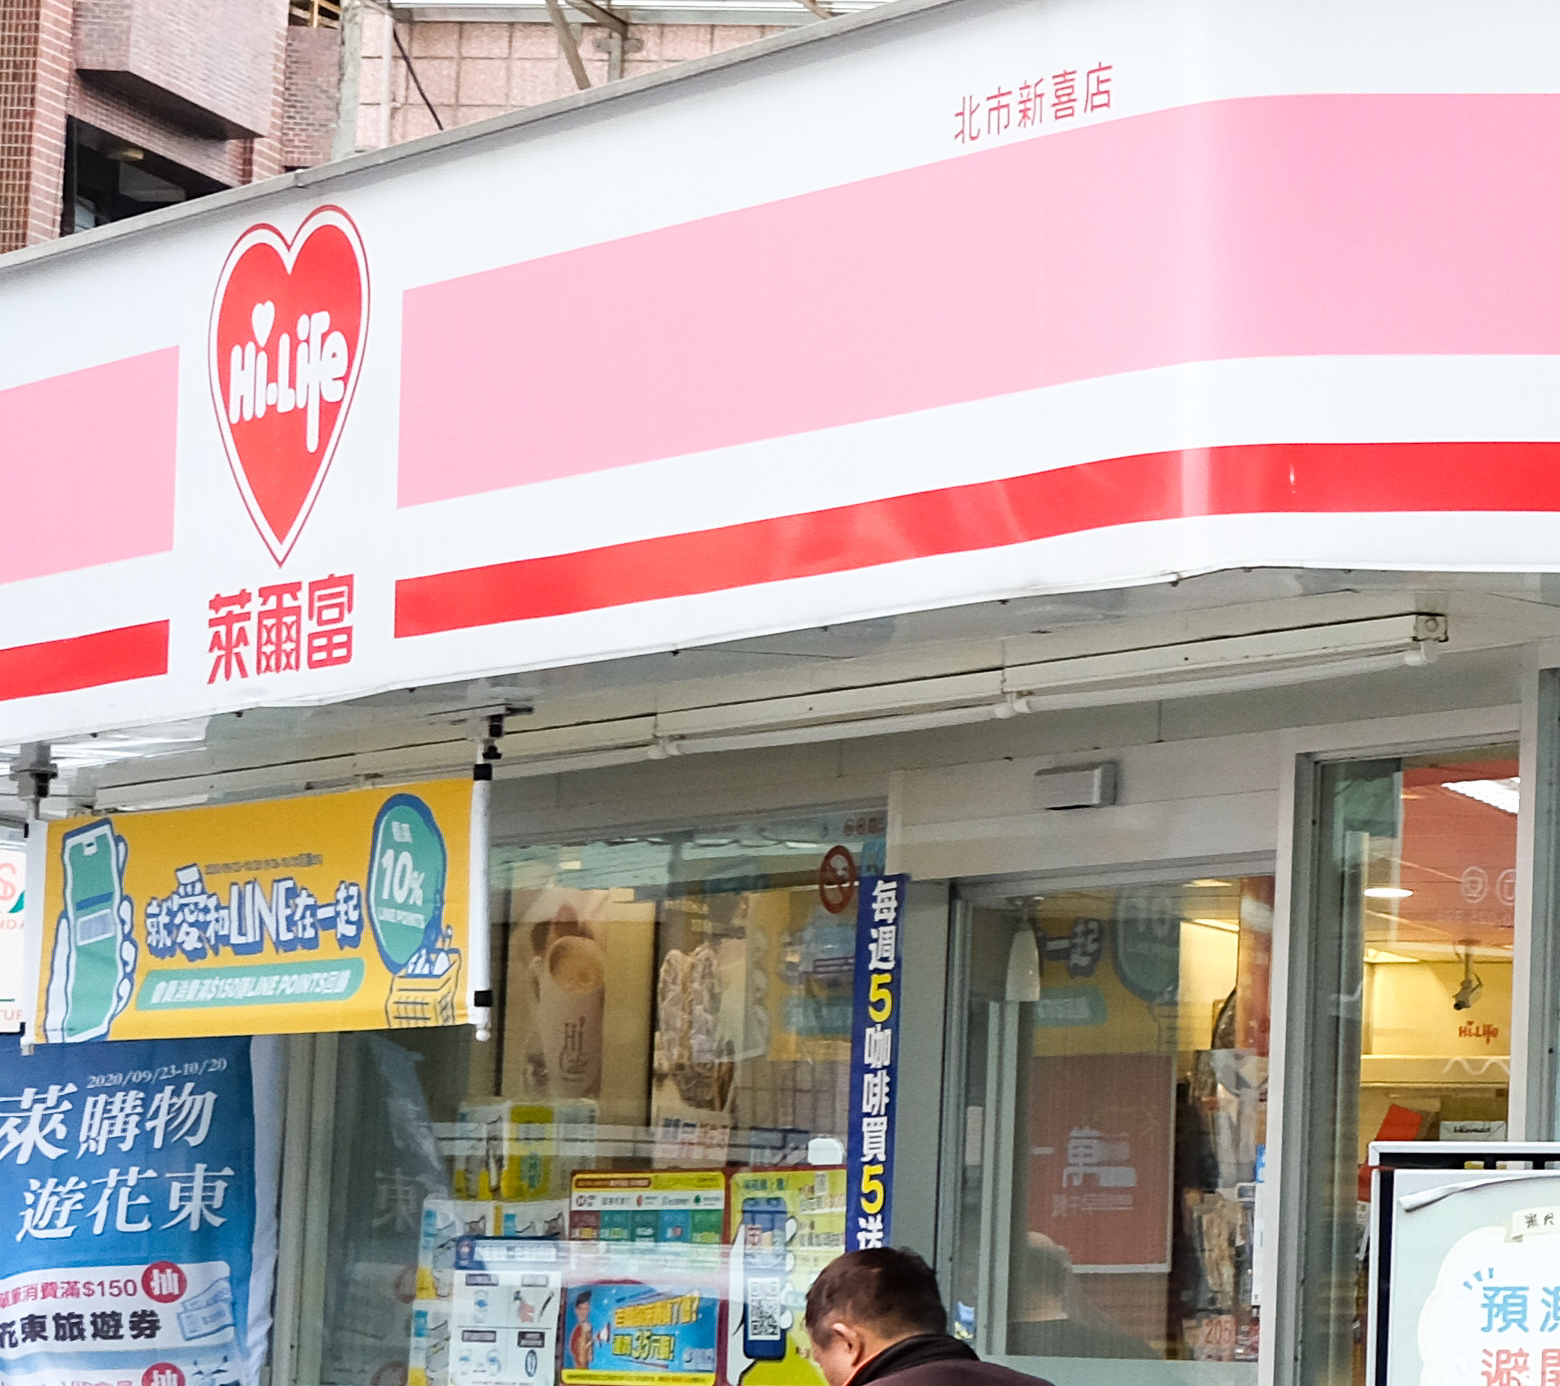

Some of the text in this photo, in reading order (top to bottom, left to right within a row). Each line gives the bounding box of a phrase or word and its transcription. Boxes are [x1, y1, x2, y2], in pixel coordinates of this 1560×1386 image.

[954, 61, 1113, 144] 北市新喜店
[206, 573, 356, 686] 萊爾富
[14, 1163, 236, 1243] 遊花東
